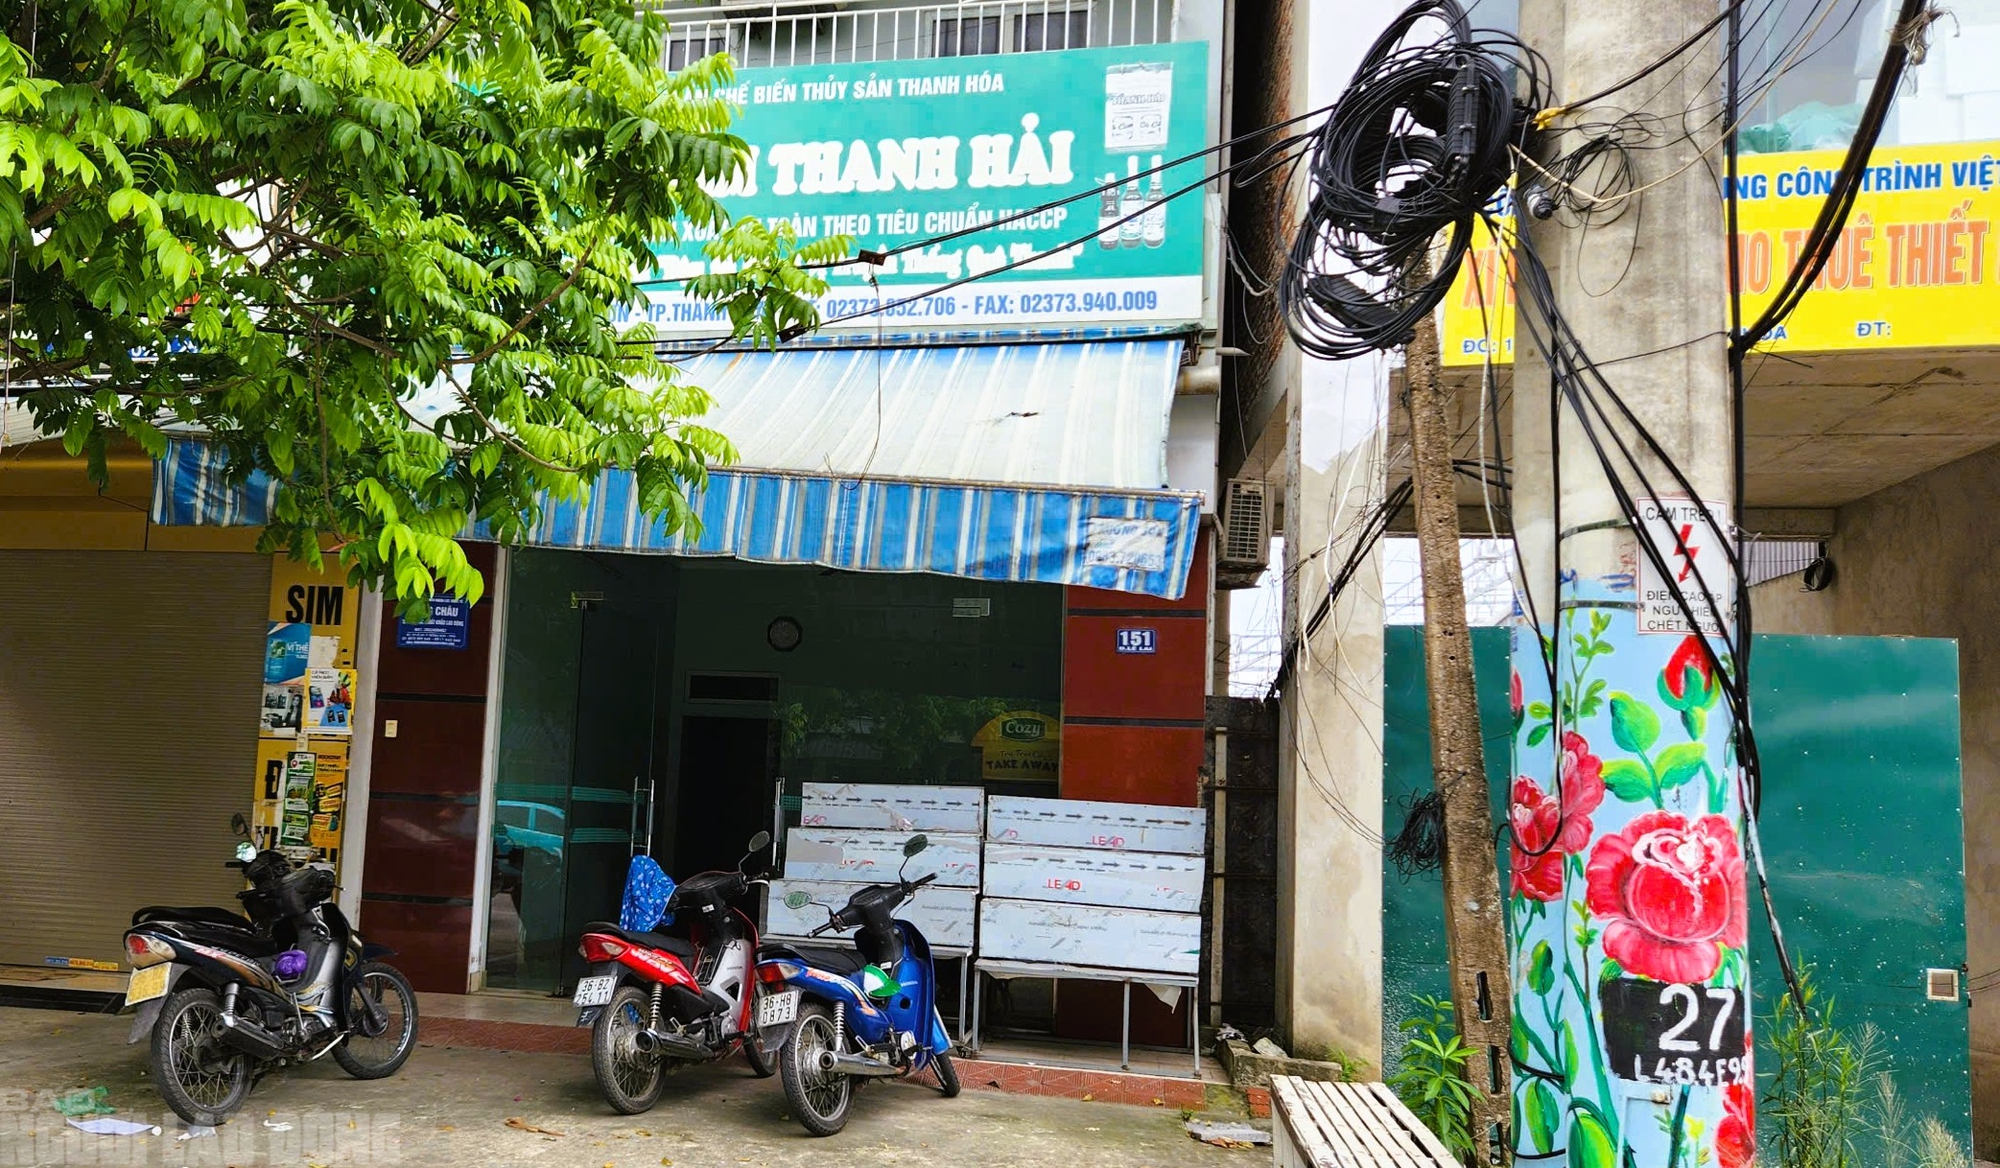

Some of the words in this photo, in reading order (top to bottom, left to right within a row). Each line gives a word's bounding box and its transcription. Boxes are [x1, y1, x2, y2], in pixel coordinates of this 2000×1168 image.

[754, 77, 796, 104] BIẾN
[802, 75, 847, 101] THỦY
[853, 73, 892, 98] SẢN
[898, 76, 959, 97] THANH
[965, 72, 1004, 93] HÓA
[768, 136, 960, 194] THANH
[968, 113, 1076, 188] HẢI
[823, 214, 871, 236] THEO
[877, 209, 918, 236] TIÊU
[925, 202, 993, 234] CHUẨN
[998, 206, 1068, 232] HACCP
[1886, 199, 1989, 287] THIẾT
[974, 295, 1014, 315] FAX:
[1020, 290, 1158, 314] 02373.940.009
[1856, 321, 1891, 337] ĐT:
[286, 585, 343, 626] SIM
[1119, 631, 1151, 646] 151
[1005, 720, 1041, 737] Cozy
[986, 760, 1018, 770] TAKE
[1021, 760, 1059, 772] AWAY
[762, 1008, 791, 1024] 0873
[1658, 983, 1736, 1052] 27
